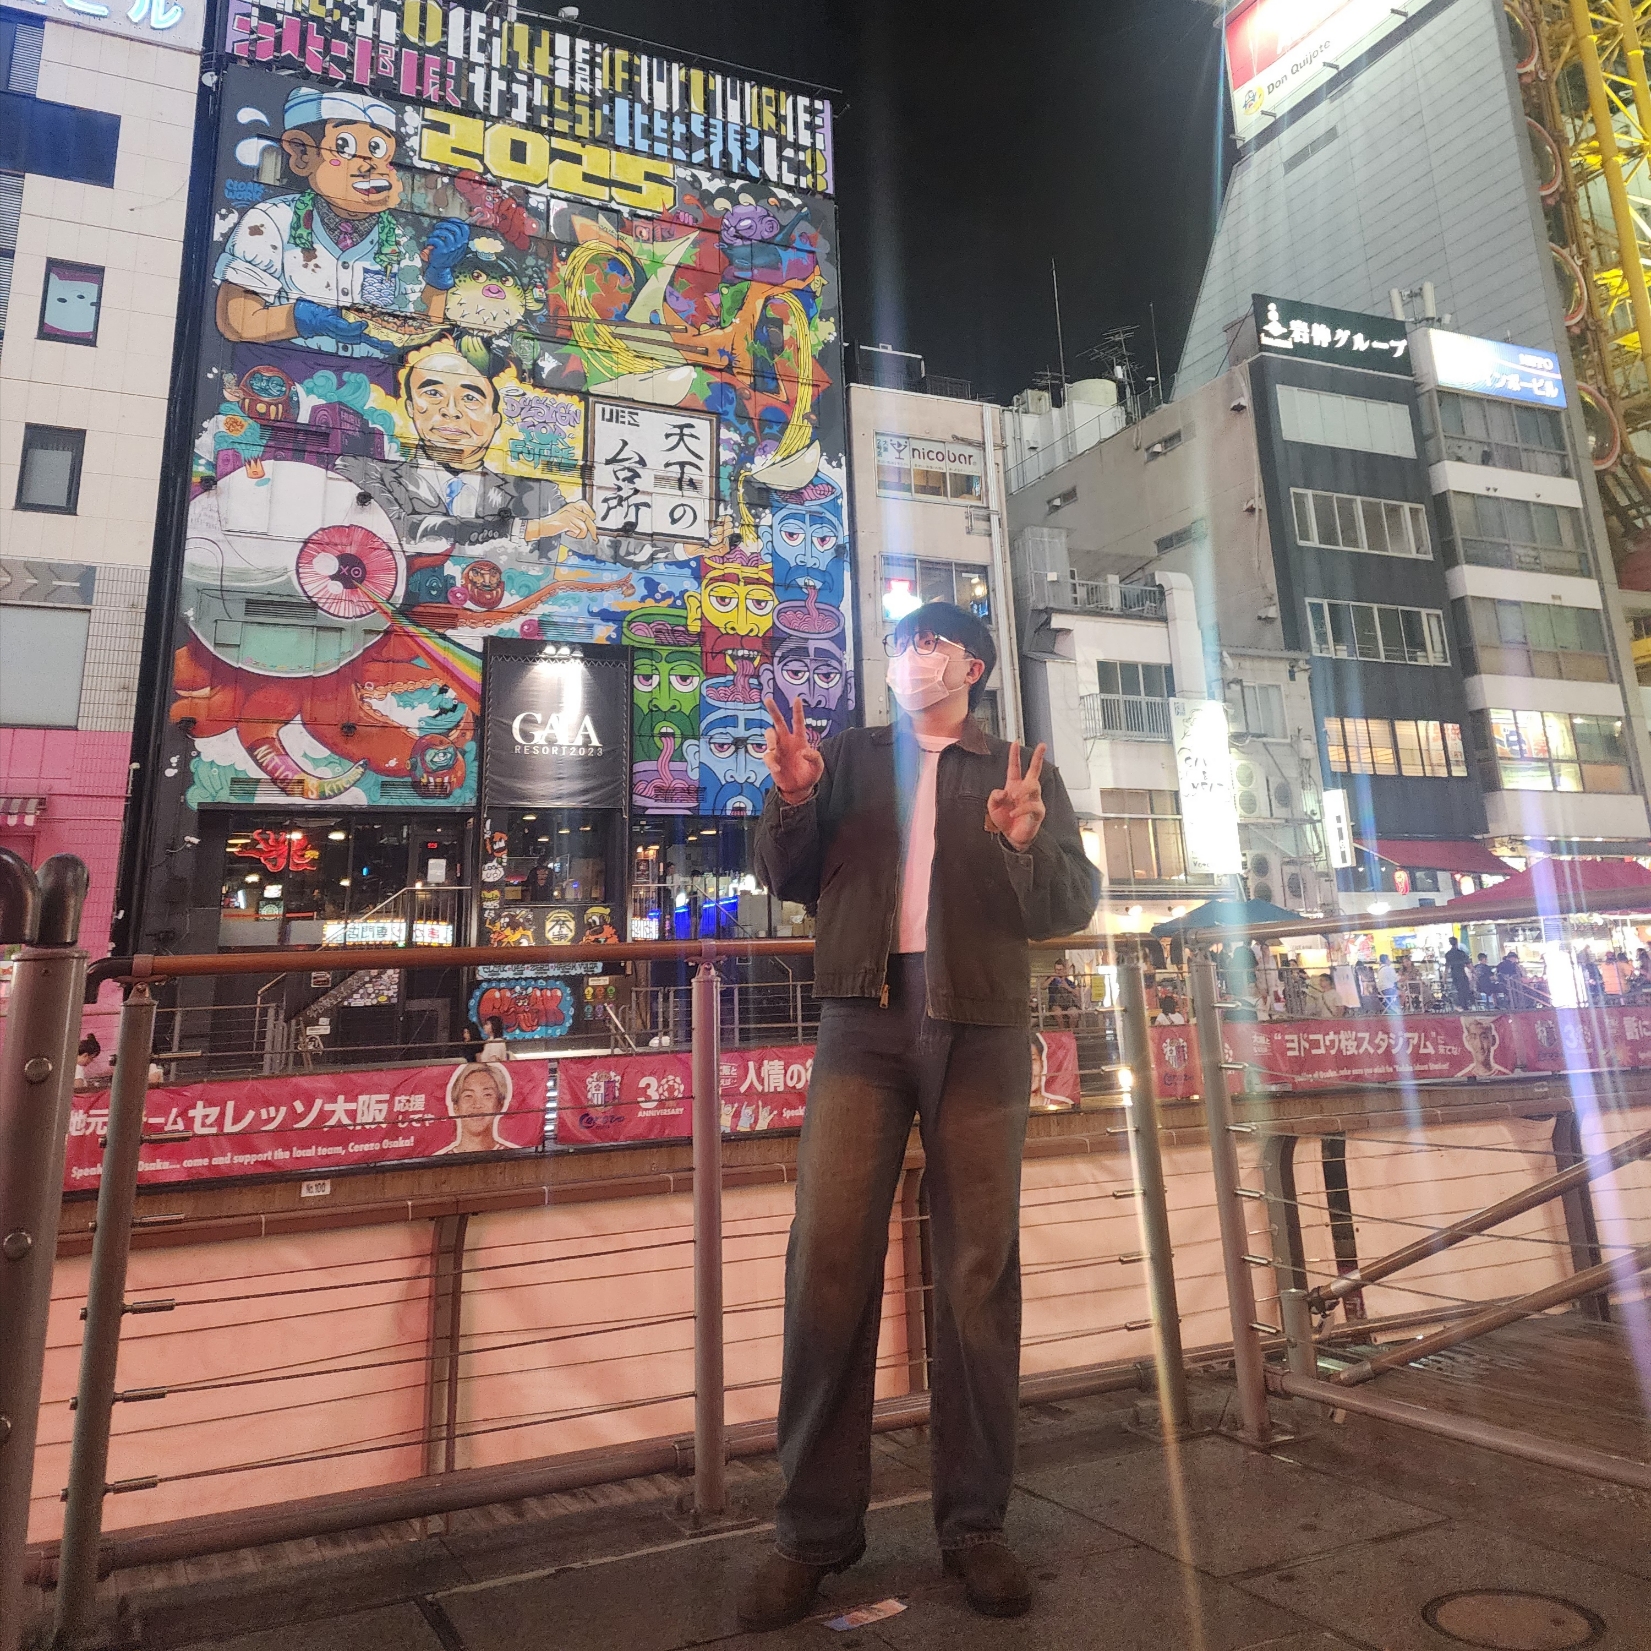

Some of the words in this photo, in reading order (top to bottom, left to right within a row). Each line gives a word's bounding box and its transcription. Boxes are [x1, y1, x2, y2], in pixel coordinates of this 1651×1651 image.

[1266, 73, 1288, 96] Don
[1290, 39, 1331, 75] Quijote
[420, 106, 677, 213] 2025
[503, 395, 581, 427] DESIGN
[517, 420, 569, 448] FOR
[508, 438, 578, 470] FUTURE
[911, 446, 974, 466] nicobar
[600, 438, 650, 533] 台所
[661, 422, 705, 530] 天下の
[69, 1107, 185, 1136] 地元ーム
[188, 1094, 391, 1134] セレッソ大阪
[637, 1107, 684, 1118] ANNIVERSARY
[183, 1158, 209, 1168] come
[212, 1153, 231, 1165] and
[233, 1149, 273, 1164] support
[274, 1149, 290, 1160] the
[293, 1145, 316, 1158] local
[318, 1143, 346, 1157] team,
[348, 1141, 381, 1153] Cerezo
[383, 1136, 415, 1150] Osaka!
